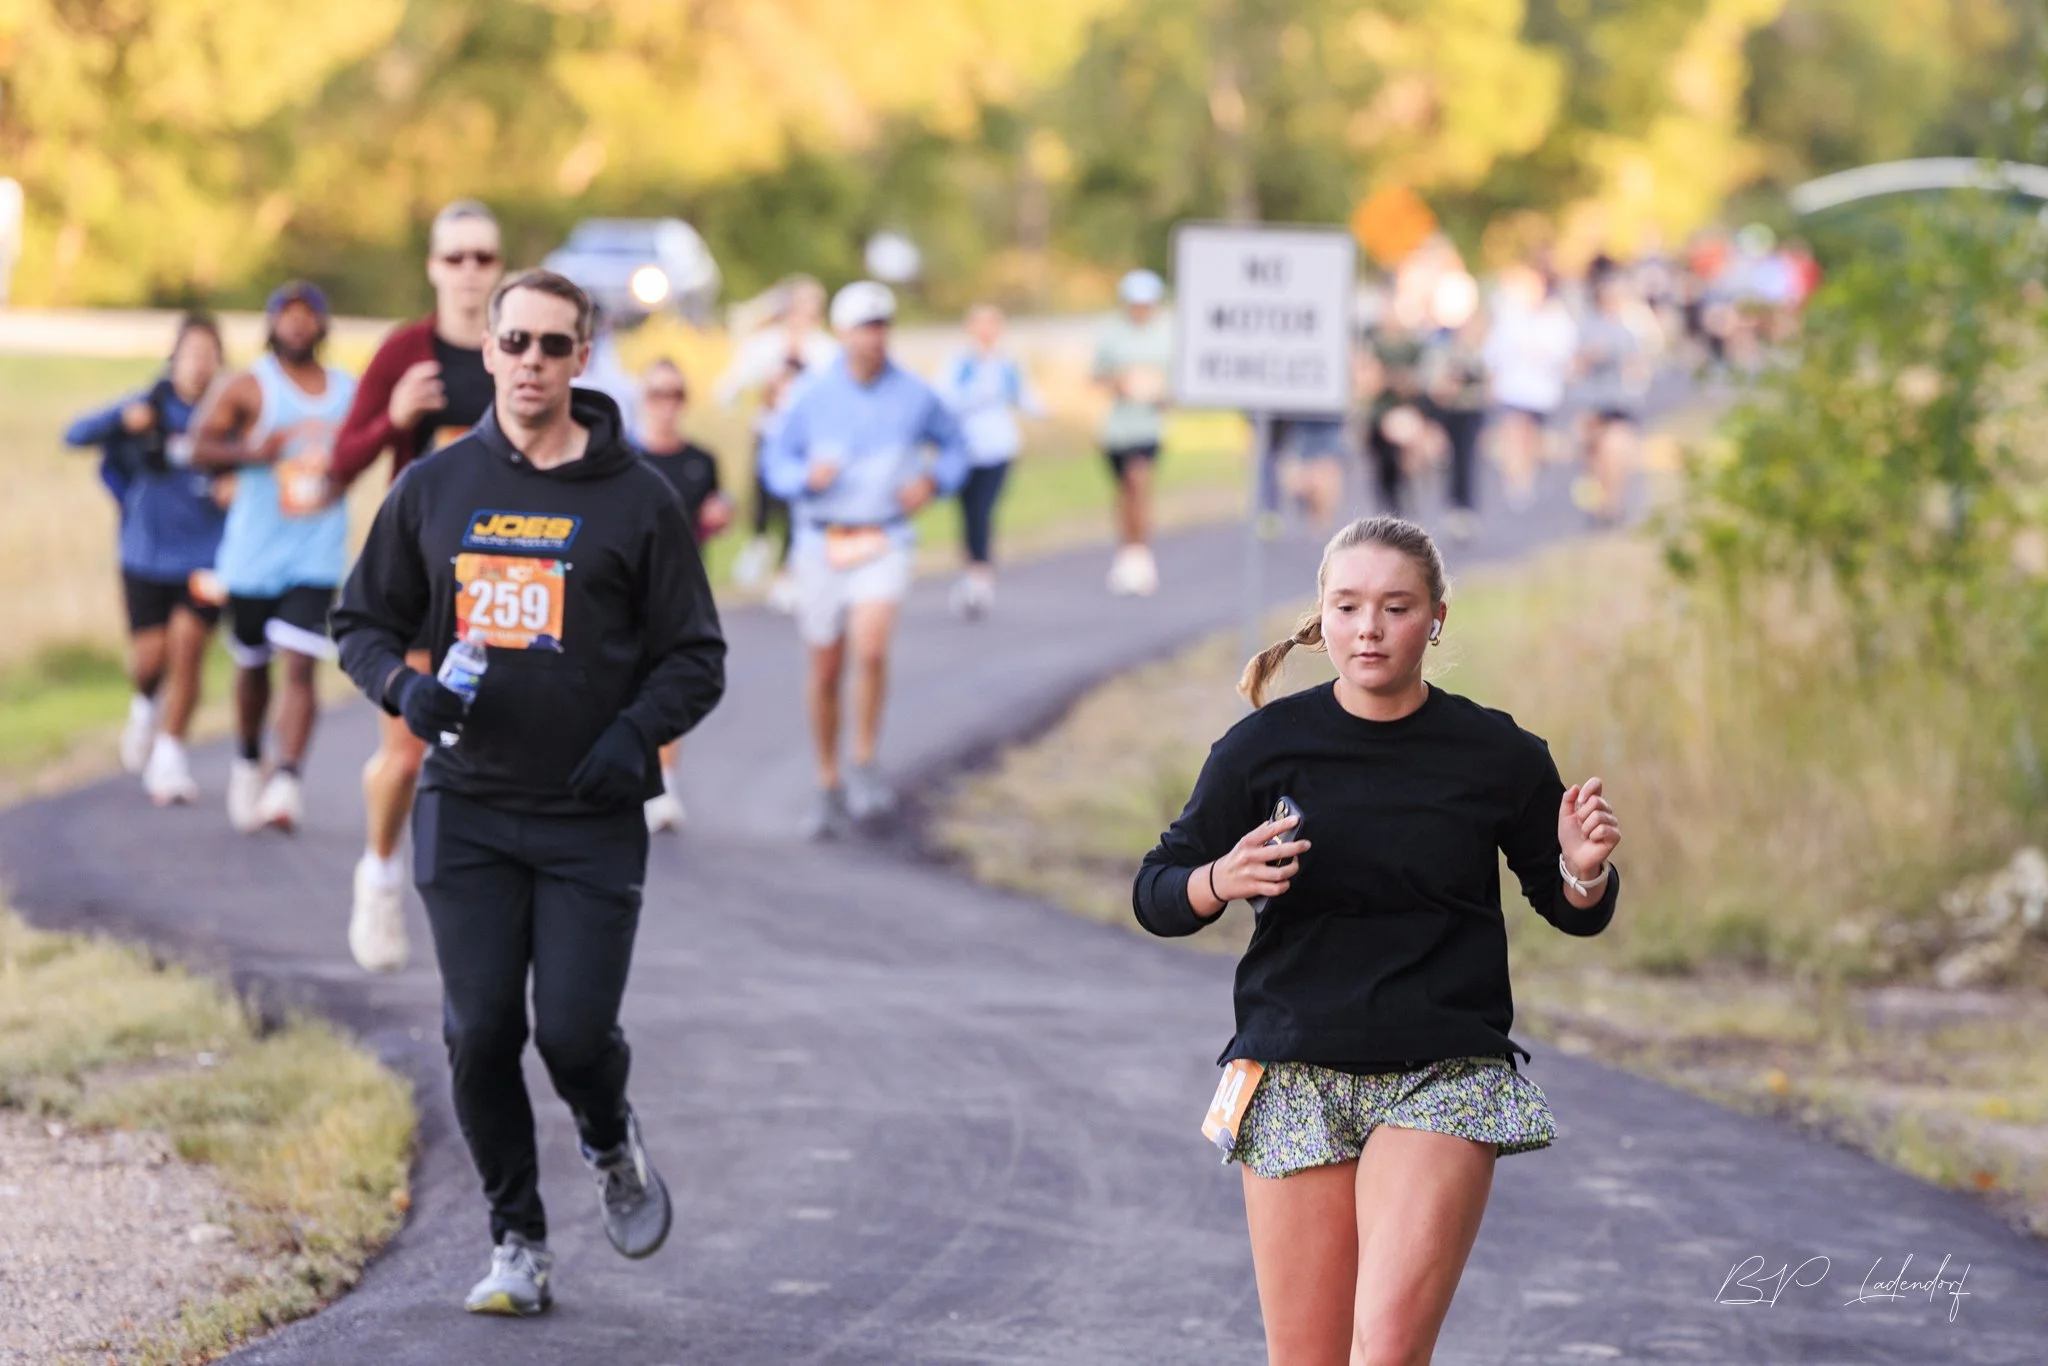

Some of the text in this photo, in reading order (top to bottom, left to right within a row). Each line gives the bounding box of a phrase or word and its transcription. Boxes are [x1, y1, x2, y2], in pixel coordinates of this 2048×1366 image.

[1243, 257, 1289, 289] NO
[473, 514, 574, 538] JOES
[469, 580, 549, 630] 259
